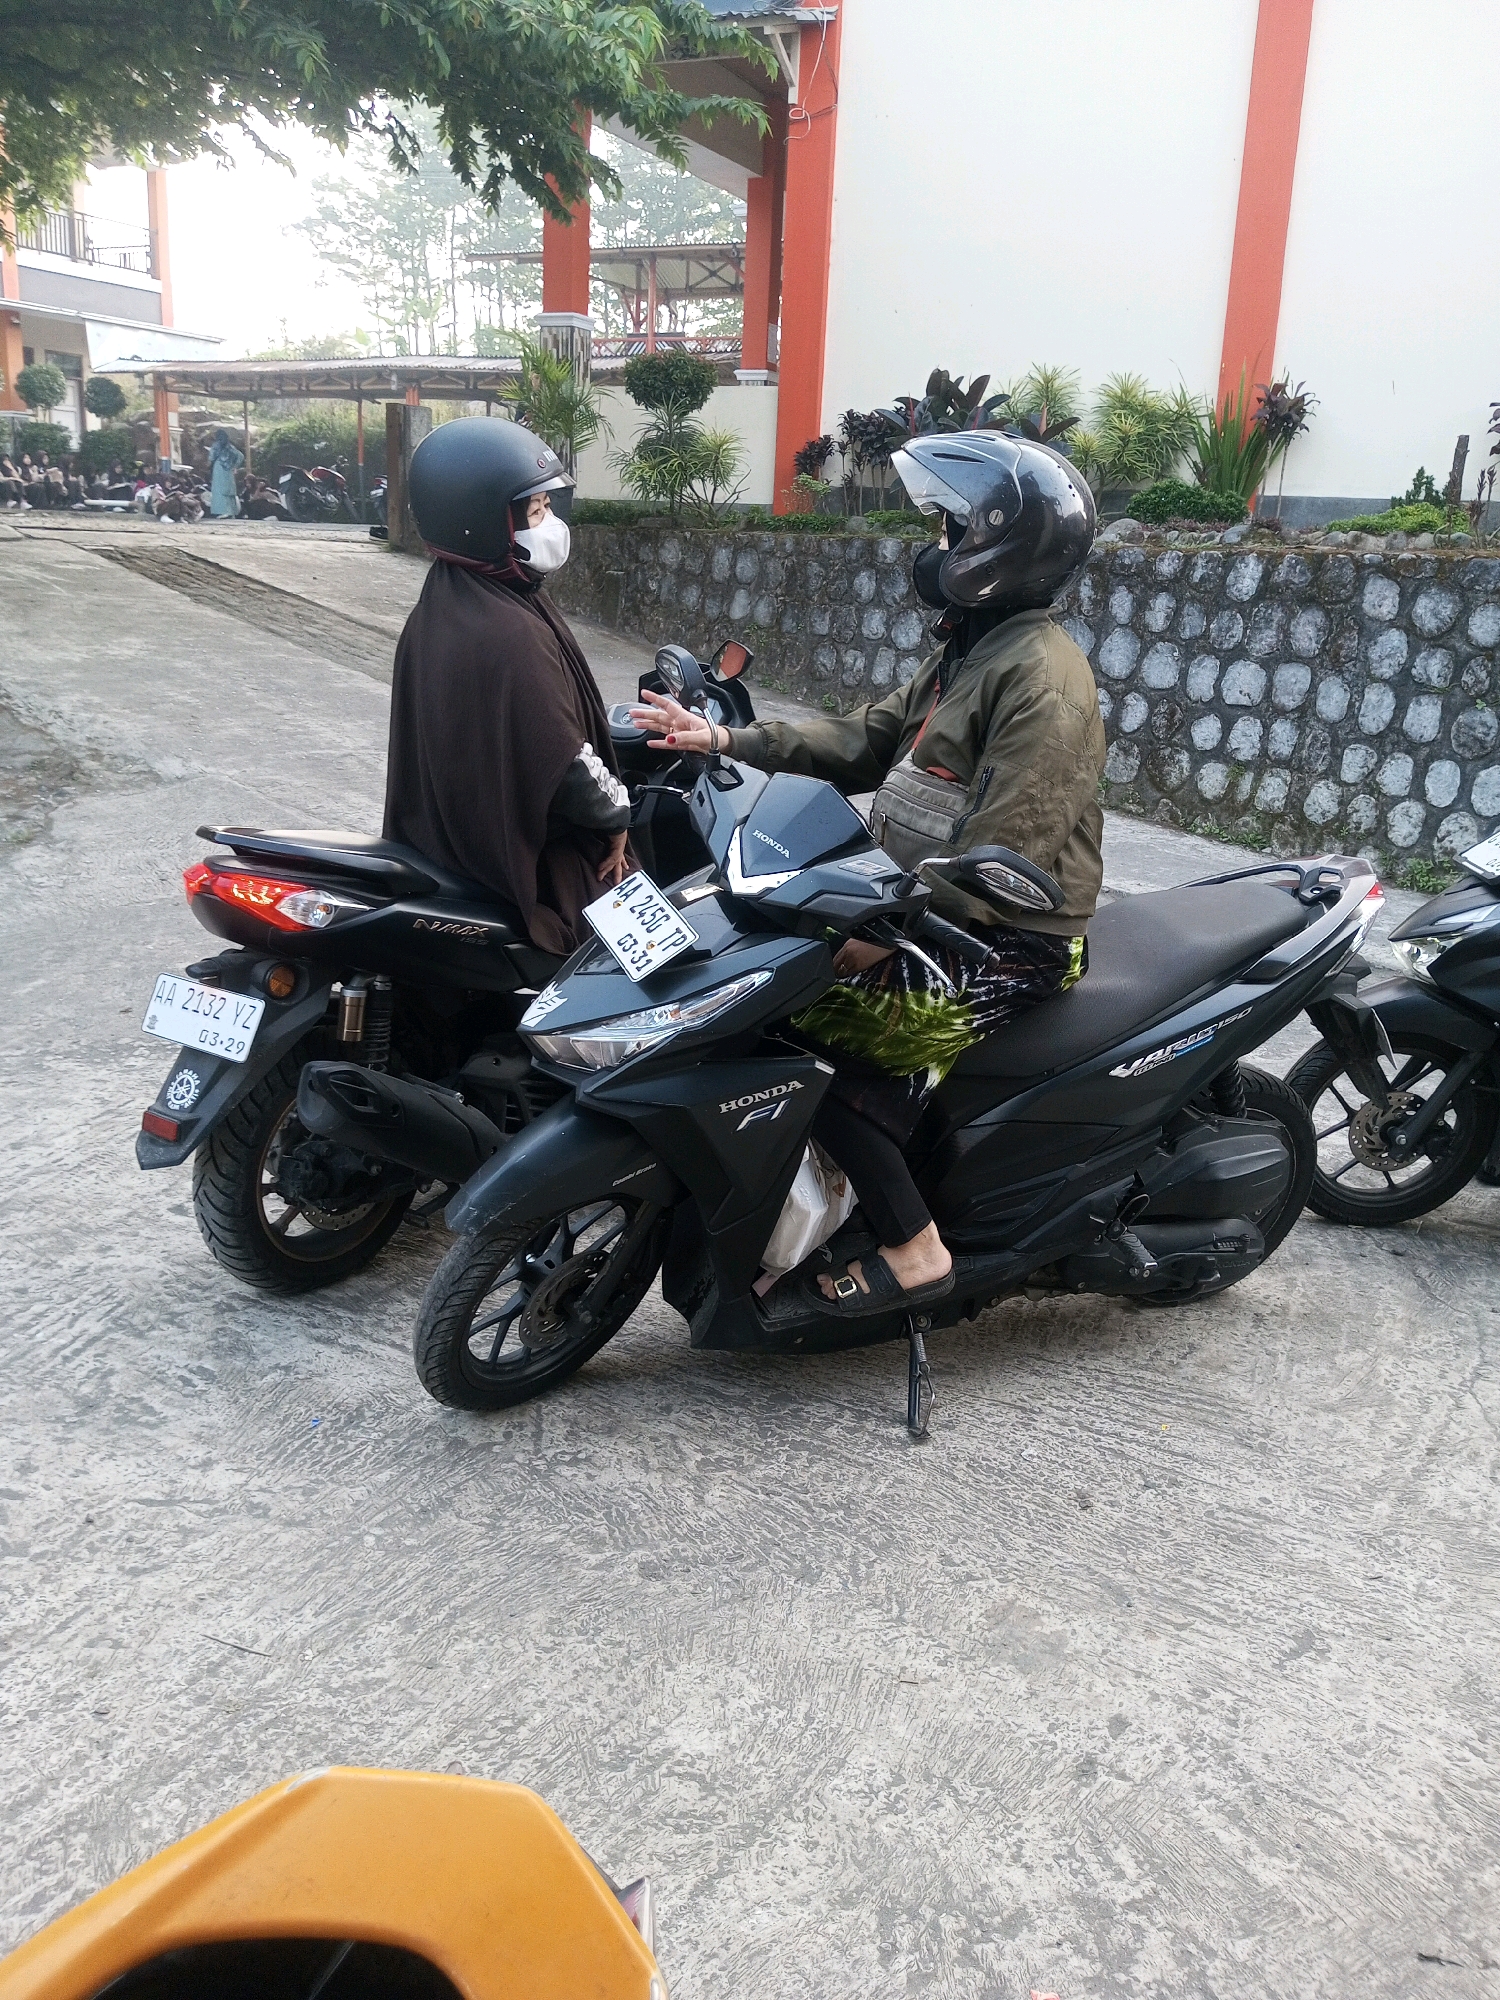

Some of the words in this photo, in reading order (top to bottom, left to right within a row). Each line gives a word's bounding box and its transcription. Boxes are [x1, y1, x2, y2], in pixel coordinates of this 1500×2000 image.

[752, 829, 790, 859] HONDA
[412, 918, 489, 938] NMAX
[613, 876, 643, 902] AA
[657, 927, 688, 952] TP
[154, 980, 177, 1007] AA
[181, 987, 227, 1020] 2132
[232, 1001, 257, 1030] YZ
[1108, 1022, 1218, 1078] VARIO
[1217, 1005, 1254, 1030] 150
[719, 1080, 805, 1114] HONDA
[736, 1098, 792, 1132] FI
